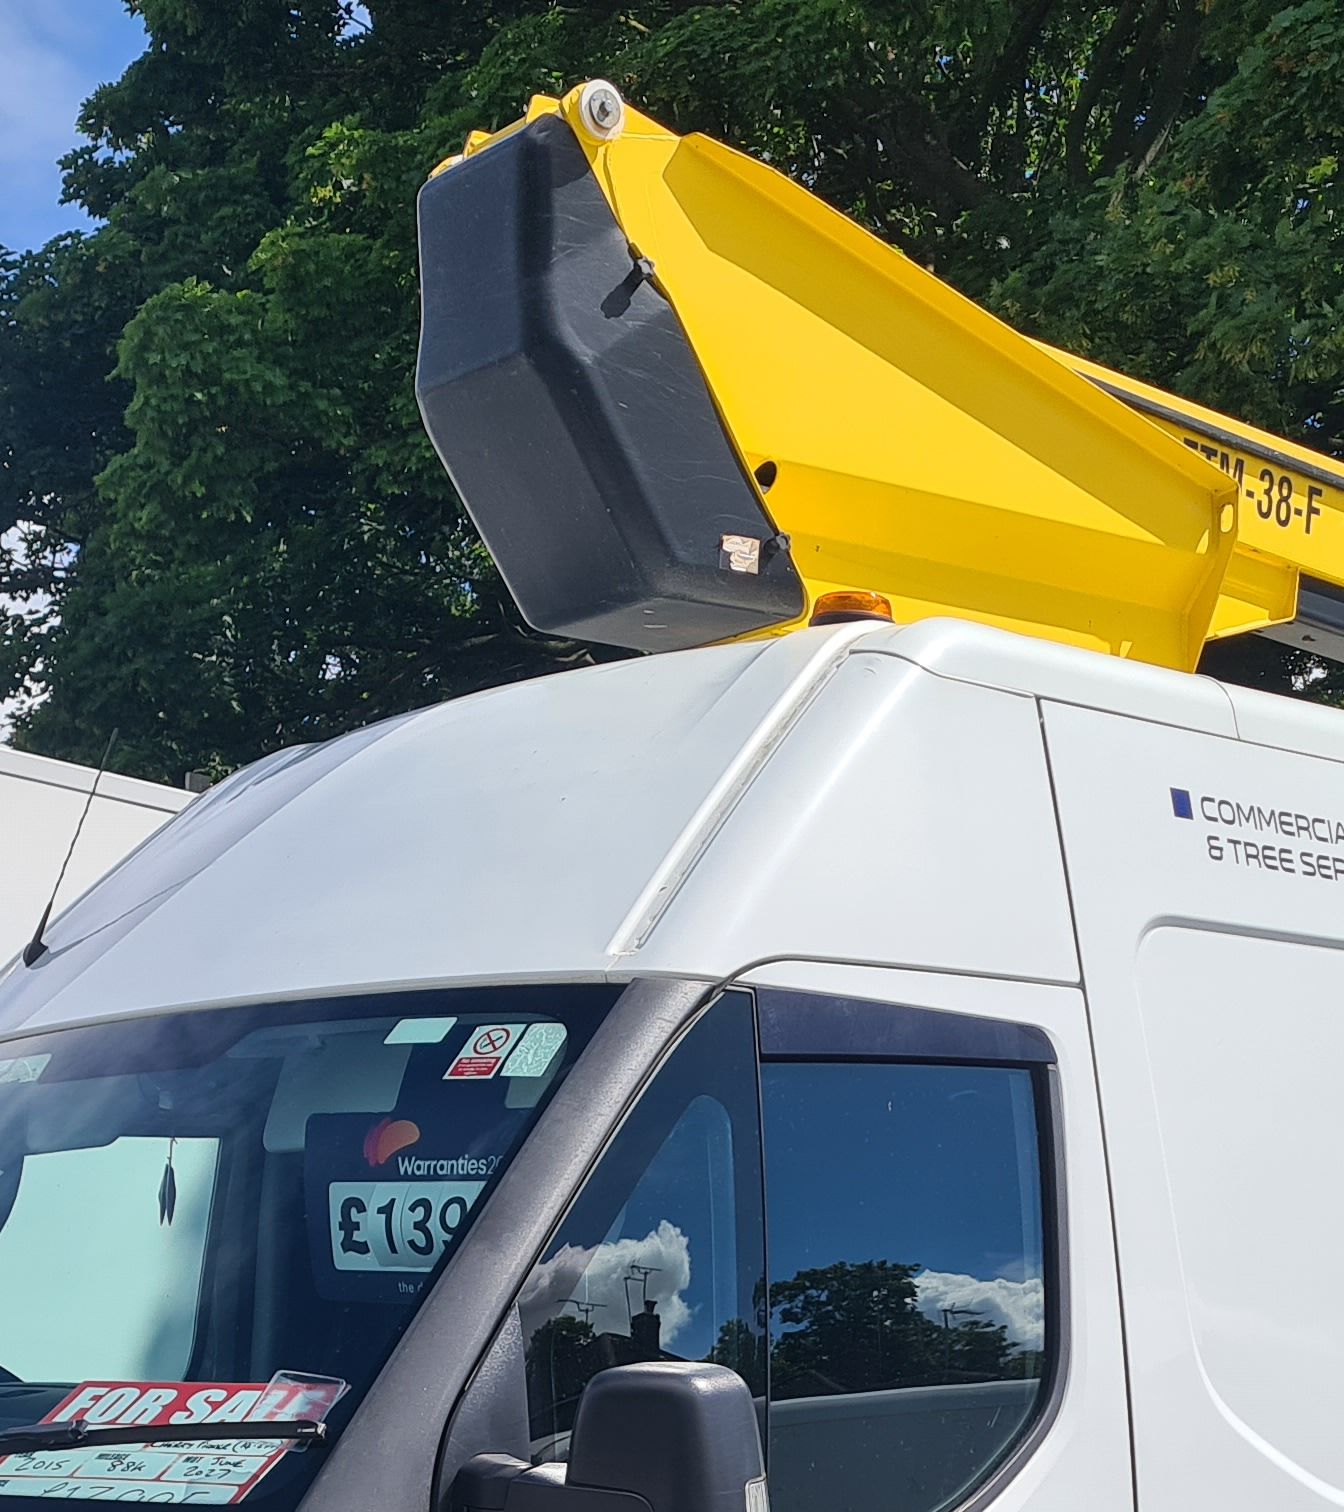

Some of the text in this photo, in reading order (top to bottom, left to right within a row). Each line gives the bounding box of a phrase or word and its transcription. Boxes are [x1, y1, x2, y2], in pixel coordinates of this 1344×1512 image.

[1207, 835, 1224, 861] &
[1227, 839, 1295, 874] TREE
[398, 1281, 415, 1293] the
[51, 1387, 178, 1424] FOR
[169, 1388, 326, 1424] SALE
